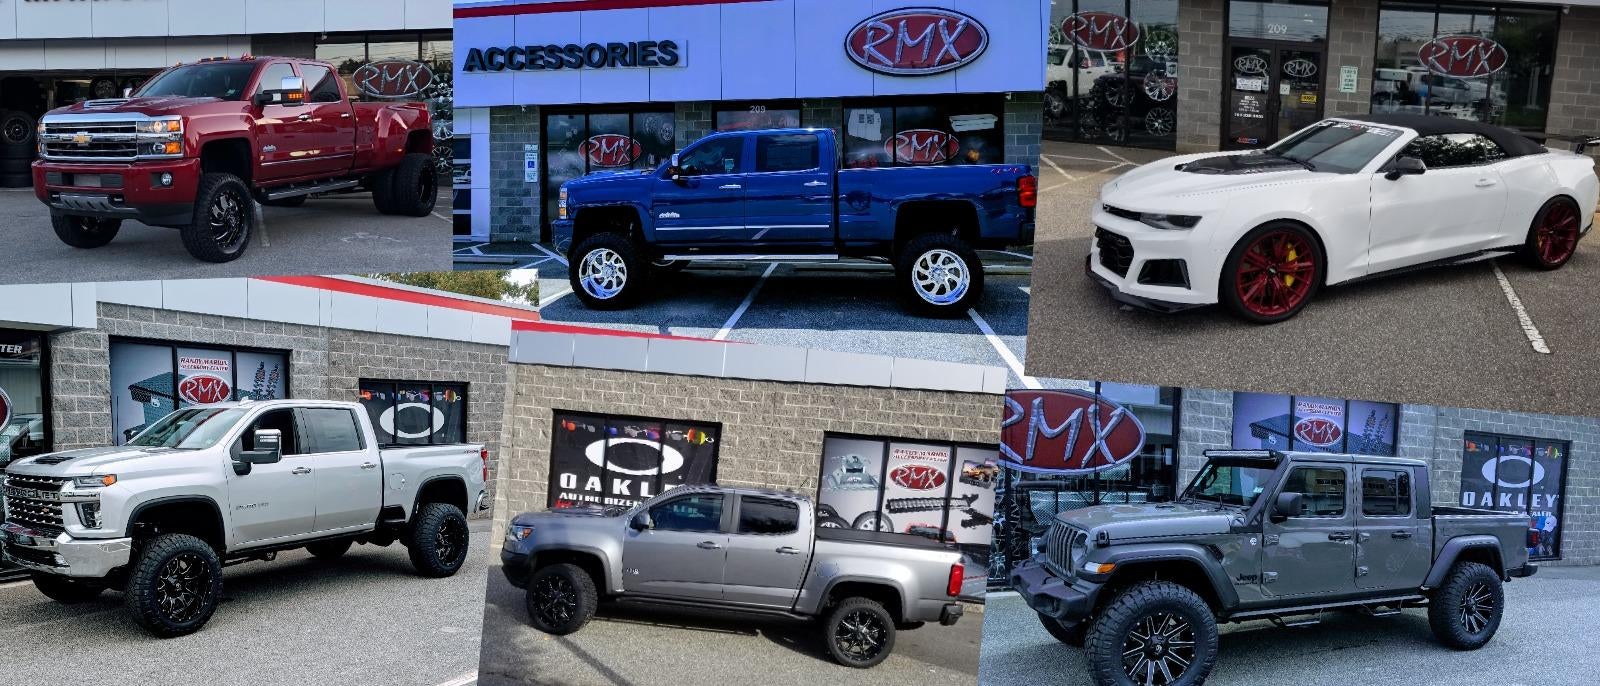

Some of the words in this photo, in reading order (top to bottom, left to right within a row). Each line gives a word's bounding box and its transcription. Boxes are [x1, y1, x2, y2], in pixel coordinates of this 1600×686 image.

[1071, 16, 1128, 49] RMX
[1267, 24, 1288, 34] 209
[863, 18, 969, 67] RMX
[463, 40, 679, 72] ACCESSORIES
[1428, 41, 1497, 76] RMX
[362, 64, 423, 94] RMX
[1287, 62, 1313, 76] RMX
[750, 105, 766, 114] 209
[586, 138, 632, 165] RMX
[895, 134, 951, 162] RMX
[186, 379, 225, 403] RMX
[1301, 421, 1336, 443] RMX
[896, 468, 939, 489] RMX
[1462, 491, 1557, 508] OAKLEY
[1236, 573, 1257, 582] Jeep
